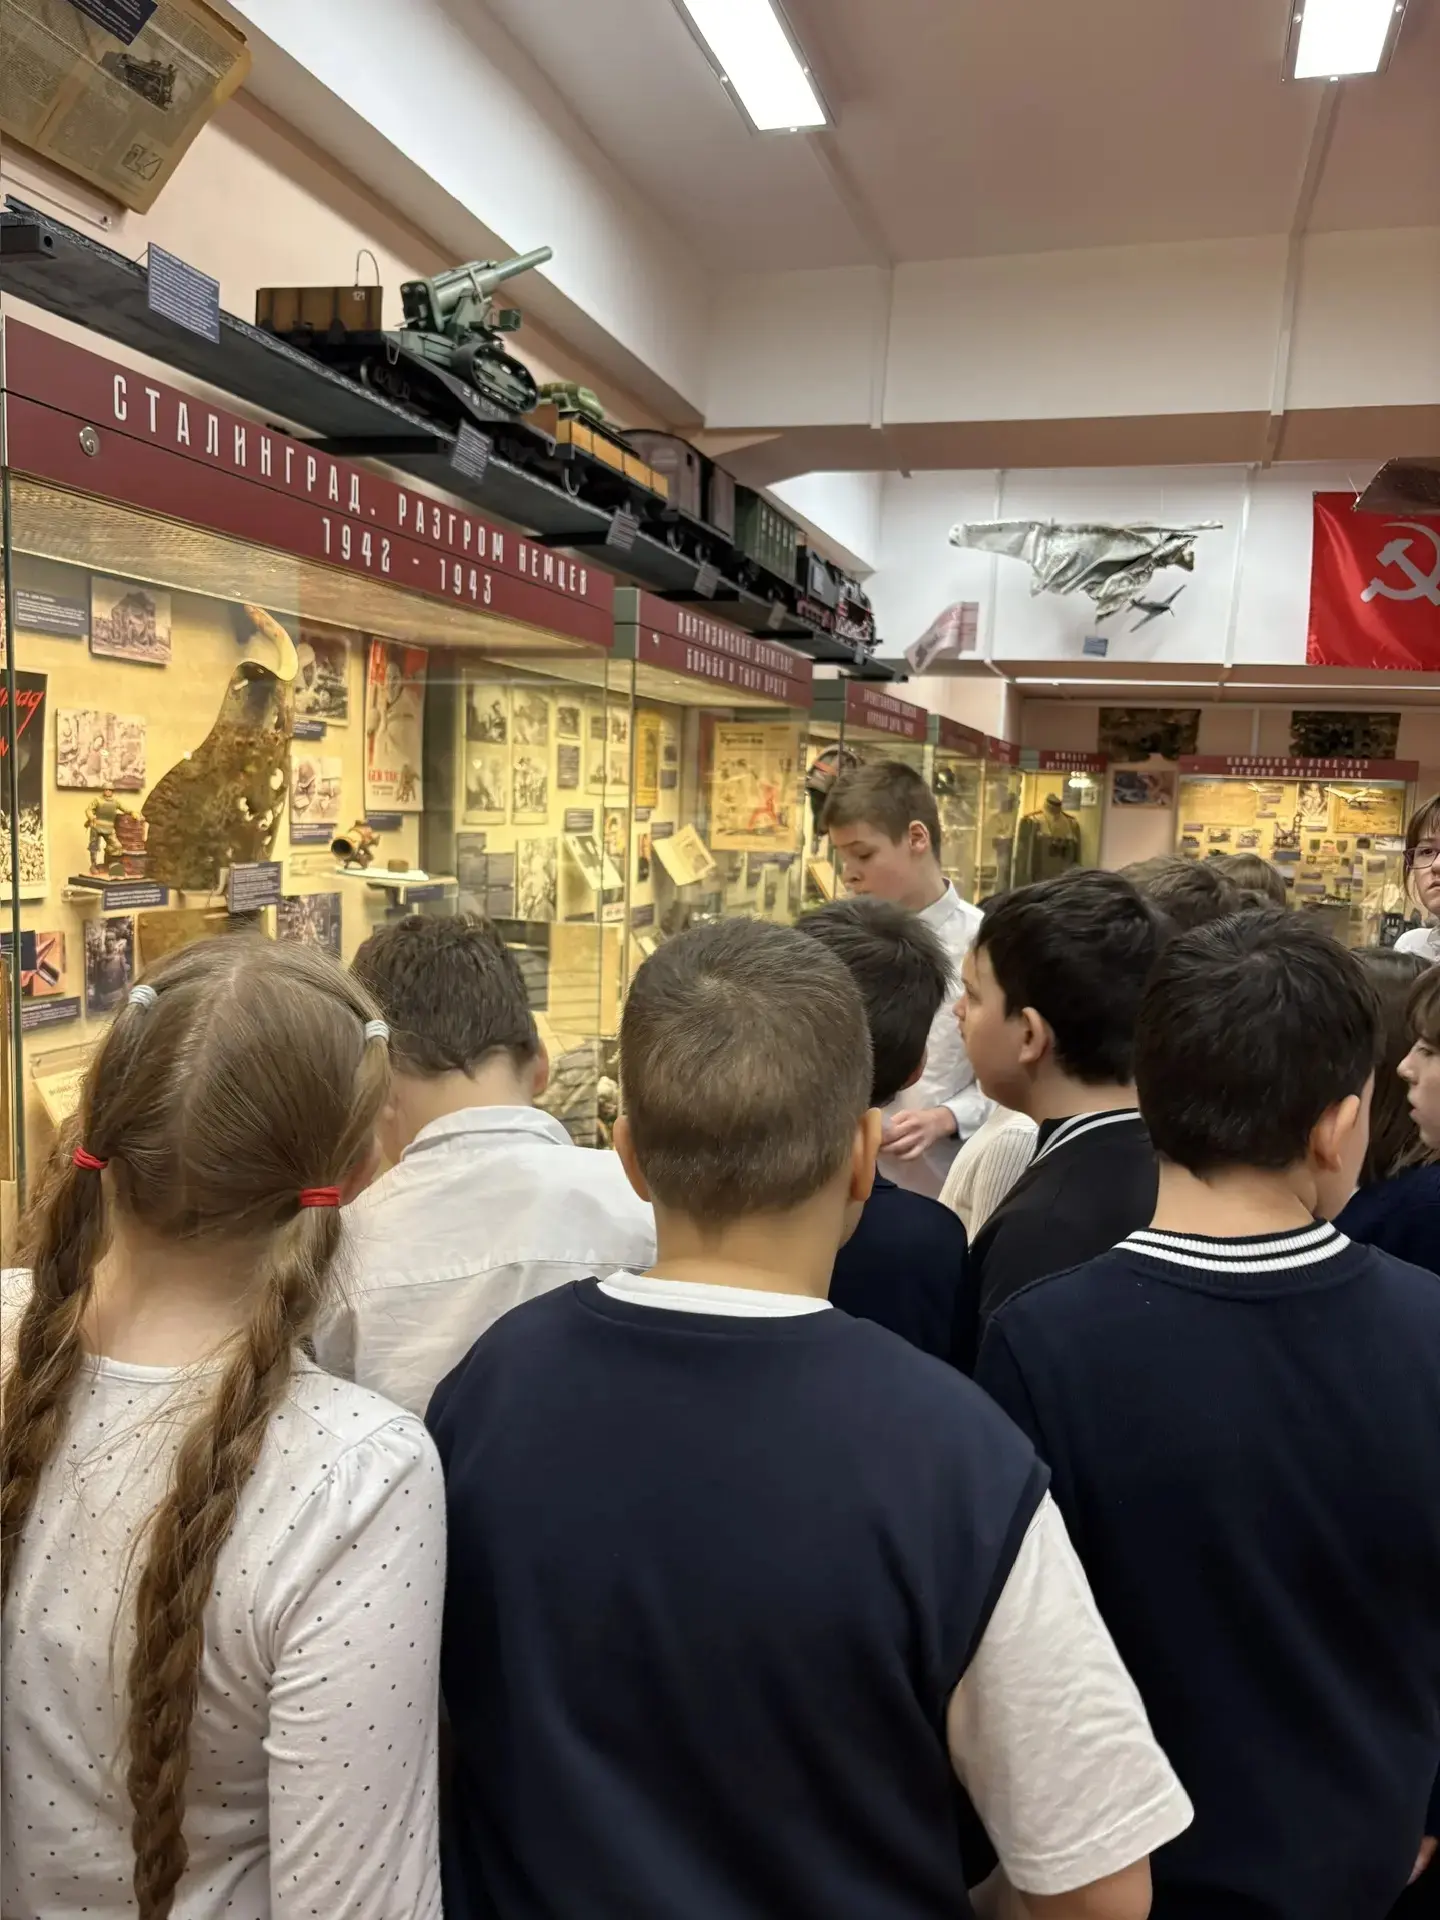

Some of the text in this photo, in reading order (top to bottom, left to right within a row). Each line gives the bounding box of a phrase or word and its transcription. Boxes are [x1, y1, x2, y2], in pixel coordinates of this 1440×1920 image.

[112, 374, 376, 516] СТАЛИНГРАД.
[397, 493, 505, 564] РАЗГРОМ
[518, 543, 588, 597] НЕМЦЕВ
[321, 517, 391, 573] 1942
[440, 558, 494, 605] 1943
